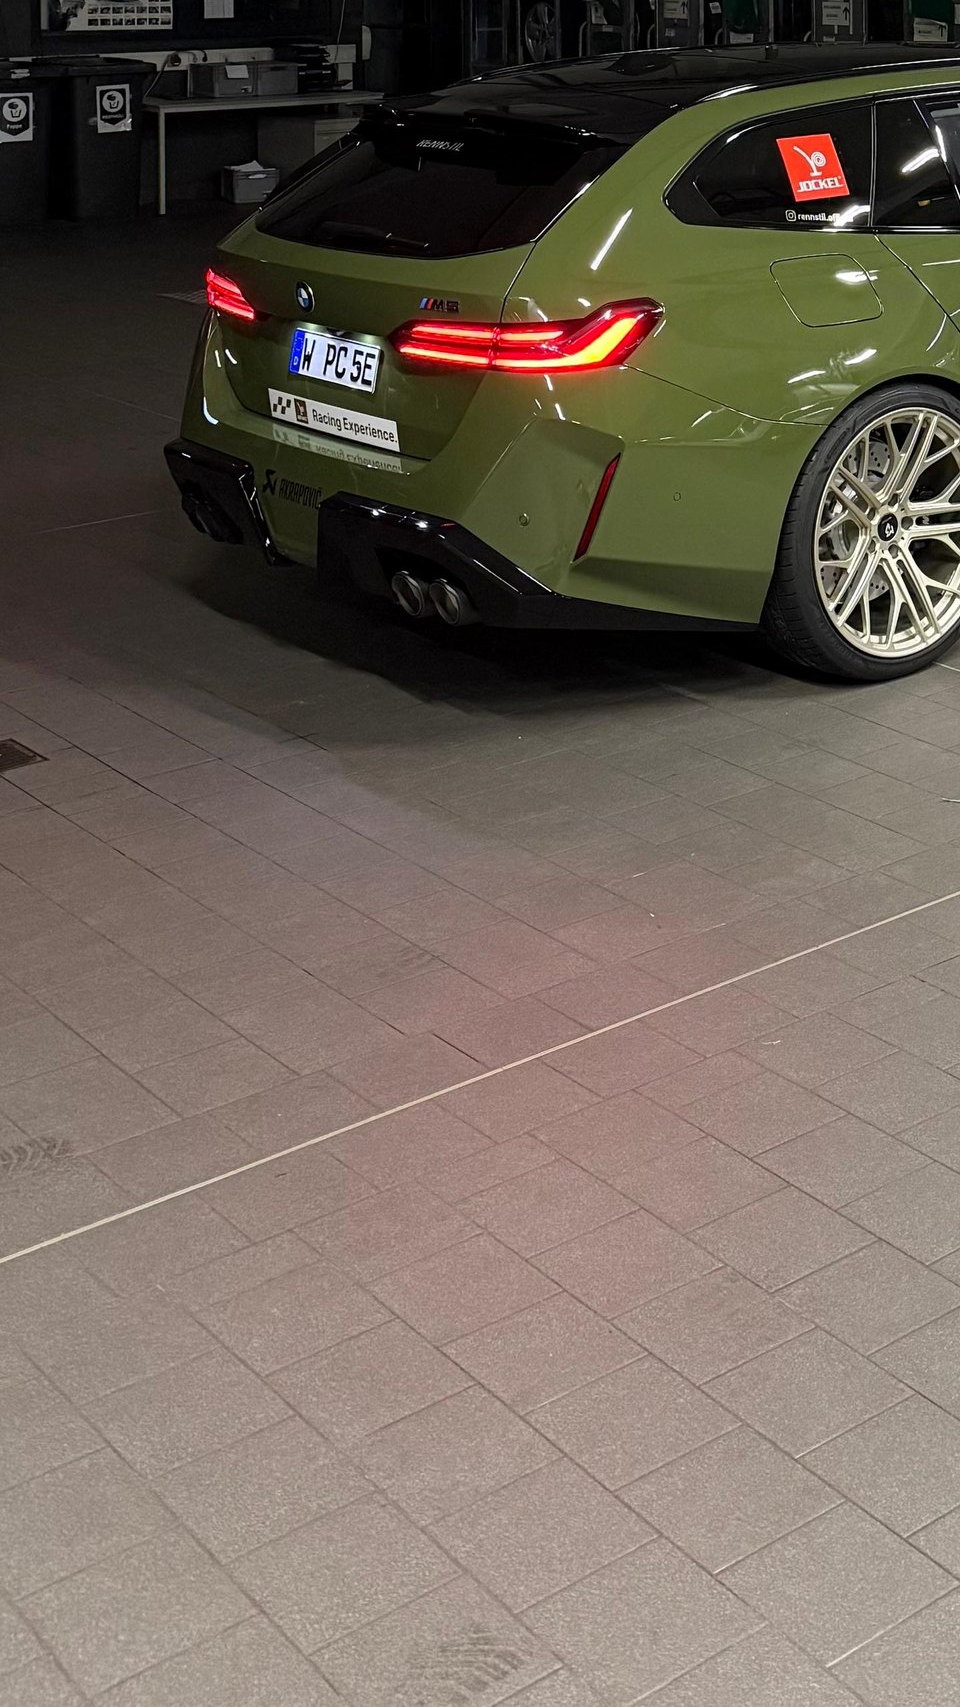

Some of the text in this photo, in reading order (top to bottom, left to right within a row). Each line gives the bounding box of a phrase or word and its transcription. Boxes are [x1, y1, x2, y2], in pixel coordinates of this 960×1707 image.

[797, 176, 844, 193] JOCKEL
[302, 337, 376, 386] W PC 5E
[312, 408, 398, 443] Racing Experience.
